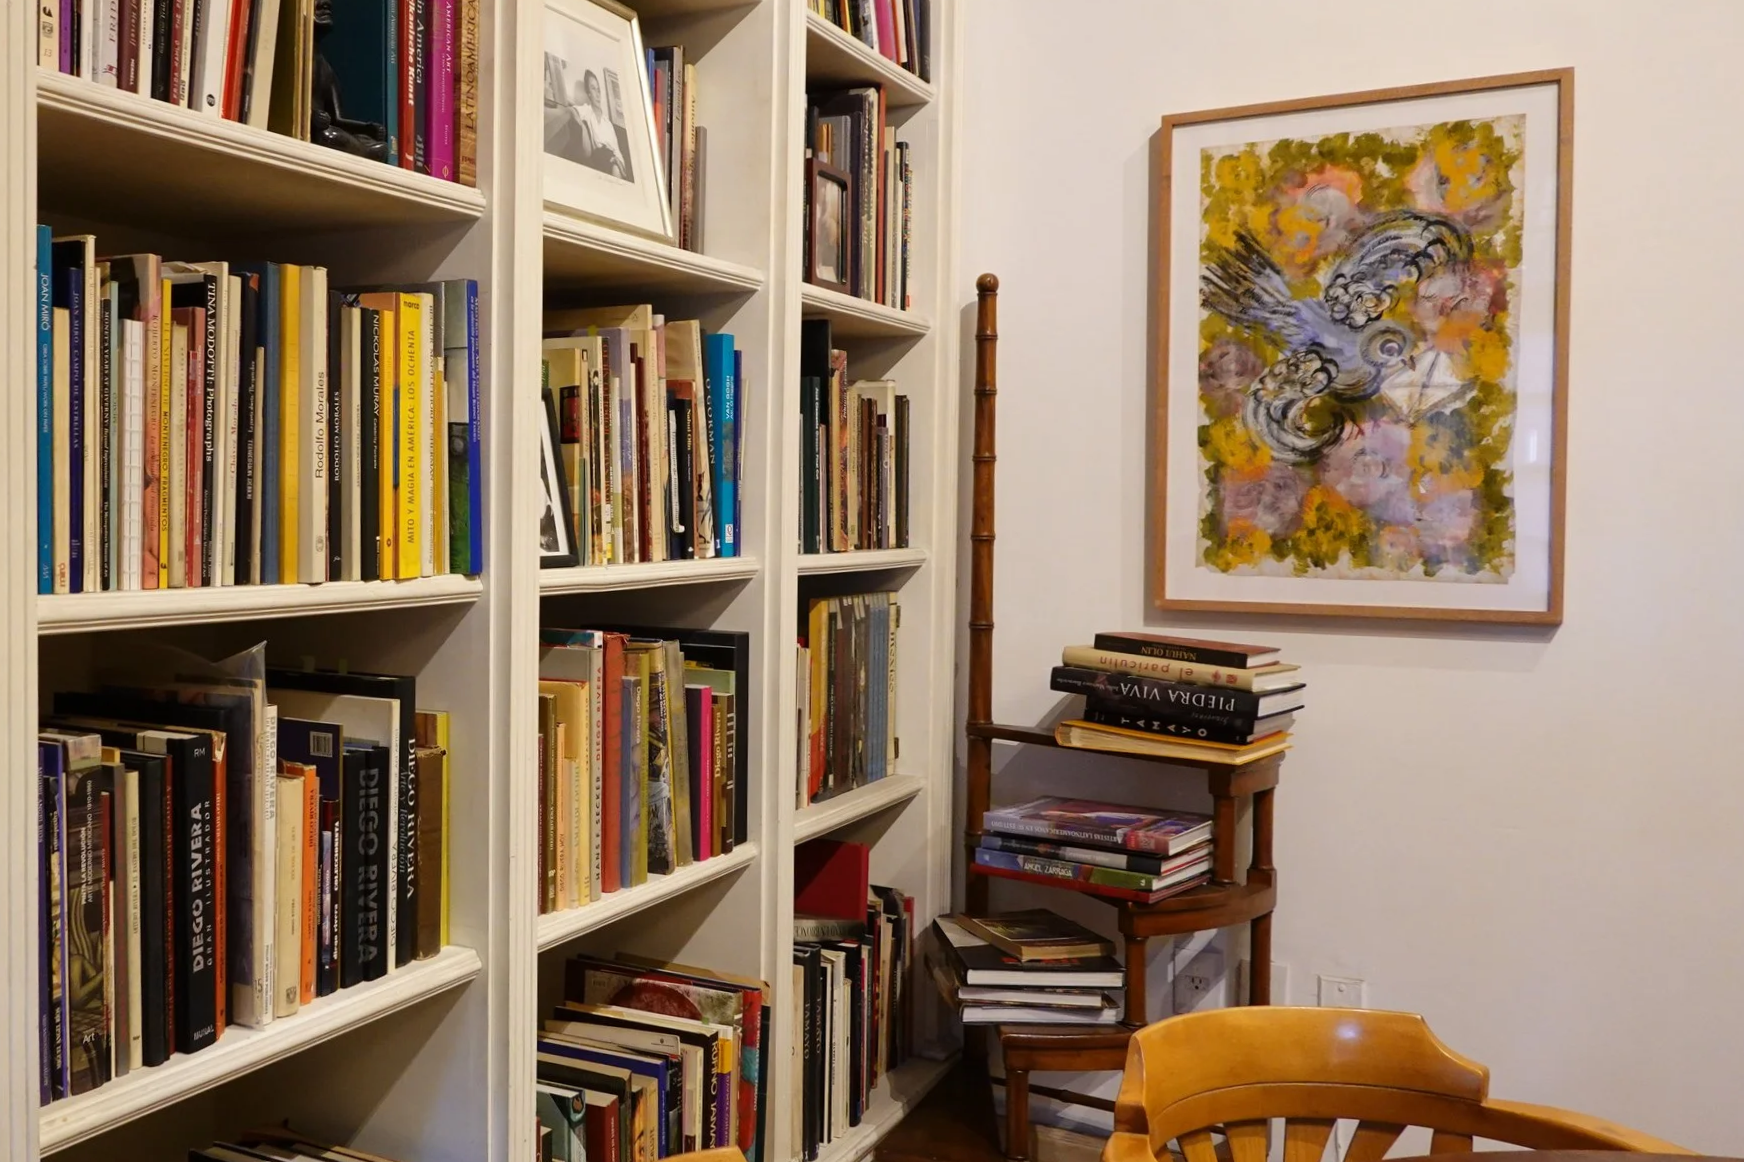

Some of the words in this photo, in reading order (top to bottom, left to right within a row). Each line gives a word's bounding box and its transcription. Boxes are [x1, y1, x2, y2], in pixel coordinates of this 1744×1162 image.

[416, 19, 425, 84] America
[407, 65, 415, 106] Kunst
[40, 273, 49, 302] JOAN
[72, 290, 80, 316] JOAN
[206, 282, 215, 315] TINA
[41, 304, 51, 331] MIRÓ
[403, 300, 420, 310] marco
[206, 317, 215, 384] MODOTTI:
[372, 314, 380, 373] NICKOLAS
[406, 330, 415, 376] OCHENTA
[73, 385, 80, 397] DE
[103, 376, 110, 386] AT
[315, 371, 325, 424] Morales
[372, 376, 380, 416] MURAY
[406, 381, 415, 400] LOS
[204, 387, 215, 462] Photographs
[230, 398, 238, 436] Morado
[102, 428, 110, 449] Beyond
[162, 411, 170, 471] MONTENEGRO
[314, 428, 324, 479] Rodolfo
[407, 456, 415, 468] EN
[407, 472, 415, 505] MAGIA
[407, 518, 415, 544] MITO
[1140, 645, 1164, 657] OLIN
[1164, 649, 1197, 661] NAHUI
[1178, 667, 1194, 680] el
[1119, 682, 1161, 702] VIVA
[1167, 688, 1236, 712] PIEDRA
[1120, 716, 1208, 738] TAMAYO
[193, 747, 206, 758] RM
[713, 745, 722, 778] Diego
[408, 738, 416, 806] DIEGO
[358, 768, 379, 856] DIEGO
[79, 827, 87, 872] REVOLUCIÓN
[191, 802, 203, 893] RIVERA
[399, 808, 409, 873] Revolución
[407, 814, 415, 899] RIVERA
[81, 873, 87, 882] LA
[390, 842, 398, 891] RIVERA
[358, 864, 378, 964] RIVERA
[192, 898, 204, 973] DIEGO
[82, 1032, 95, 1045] Art
